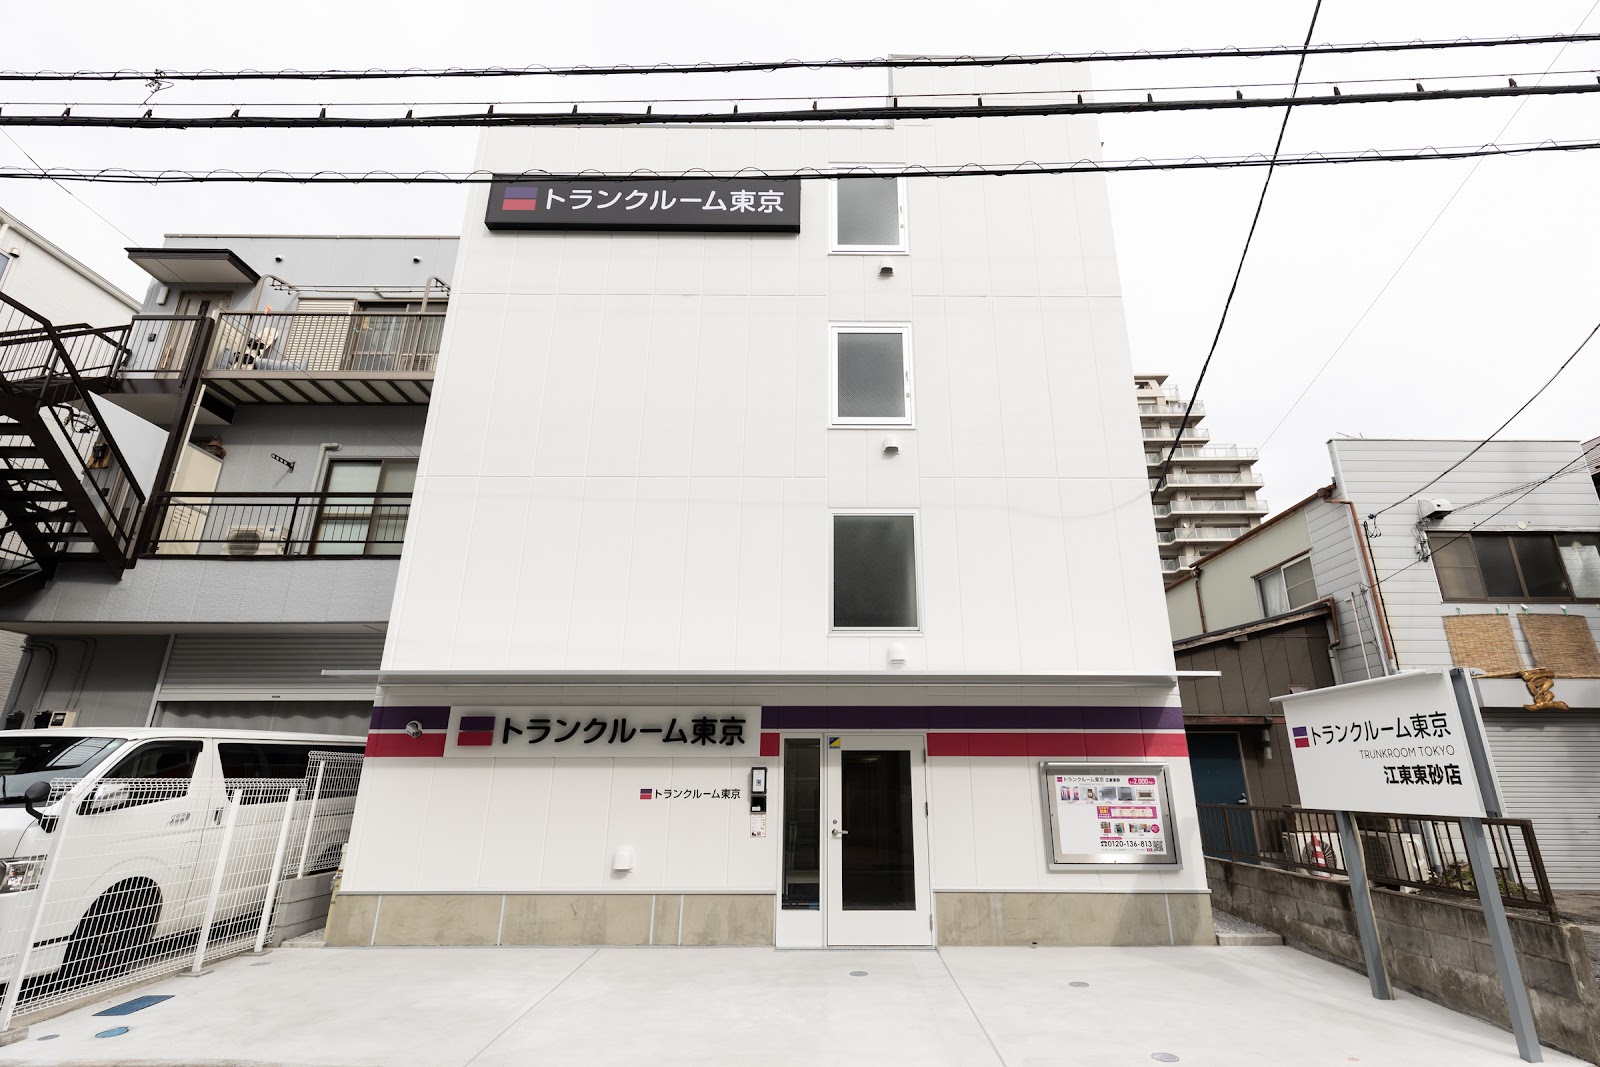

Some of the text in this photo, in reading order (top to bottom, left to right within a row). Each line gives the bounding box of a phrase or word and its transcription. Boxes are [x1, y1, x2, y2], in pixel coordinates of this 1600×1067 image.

[546, 188, 784, 213] トランクルーム東京
[502, 716, 746, 746] トランクルーム東京
[1311, 711, 1451, 745] トランクルーム東京
[1359, 745, 1455, 759] TRUNKROOM TOKYO
[1384, 764, 1462, 785] 江東東砂店
[655, 788, 741, 800] トランクルーム東京
